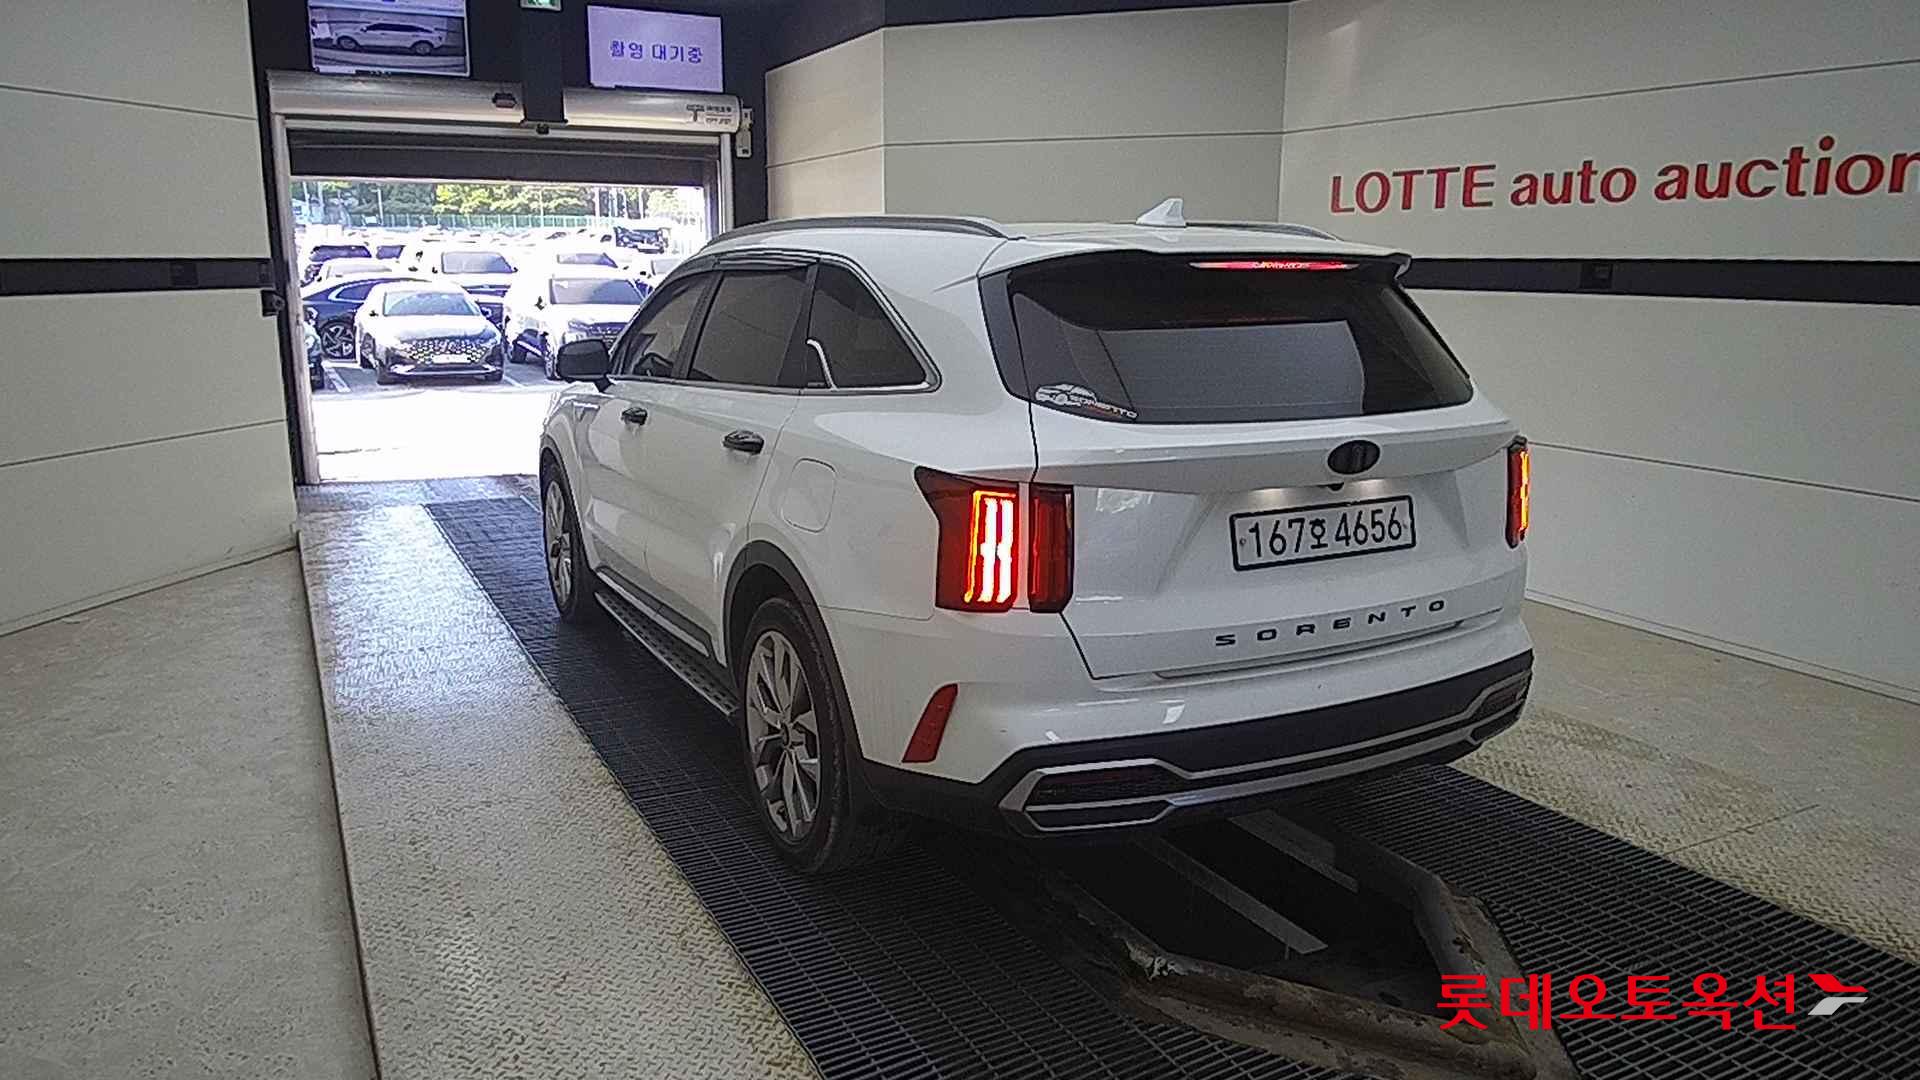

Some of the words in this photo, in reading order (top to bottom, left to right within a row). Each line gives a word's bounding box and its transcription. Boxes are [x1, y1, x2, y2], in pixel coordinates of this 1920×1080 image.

[651, 43, 703, 64] 대기중
[1330, 164, 1497, 214] LOTTE
[1511, 160, 1637, 207] auto
[1654, 136, 1920, 200] auction
[1215, 600, 1446, 646] SORENTO
